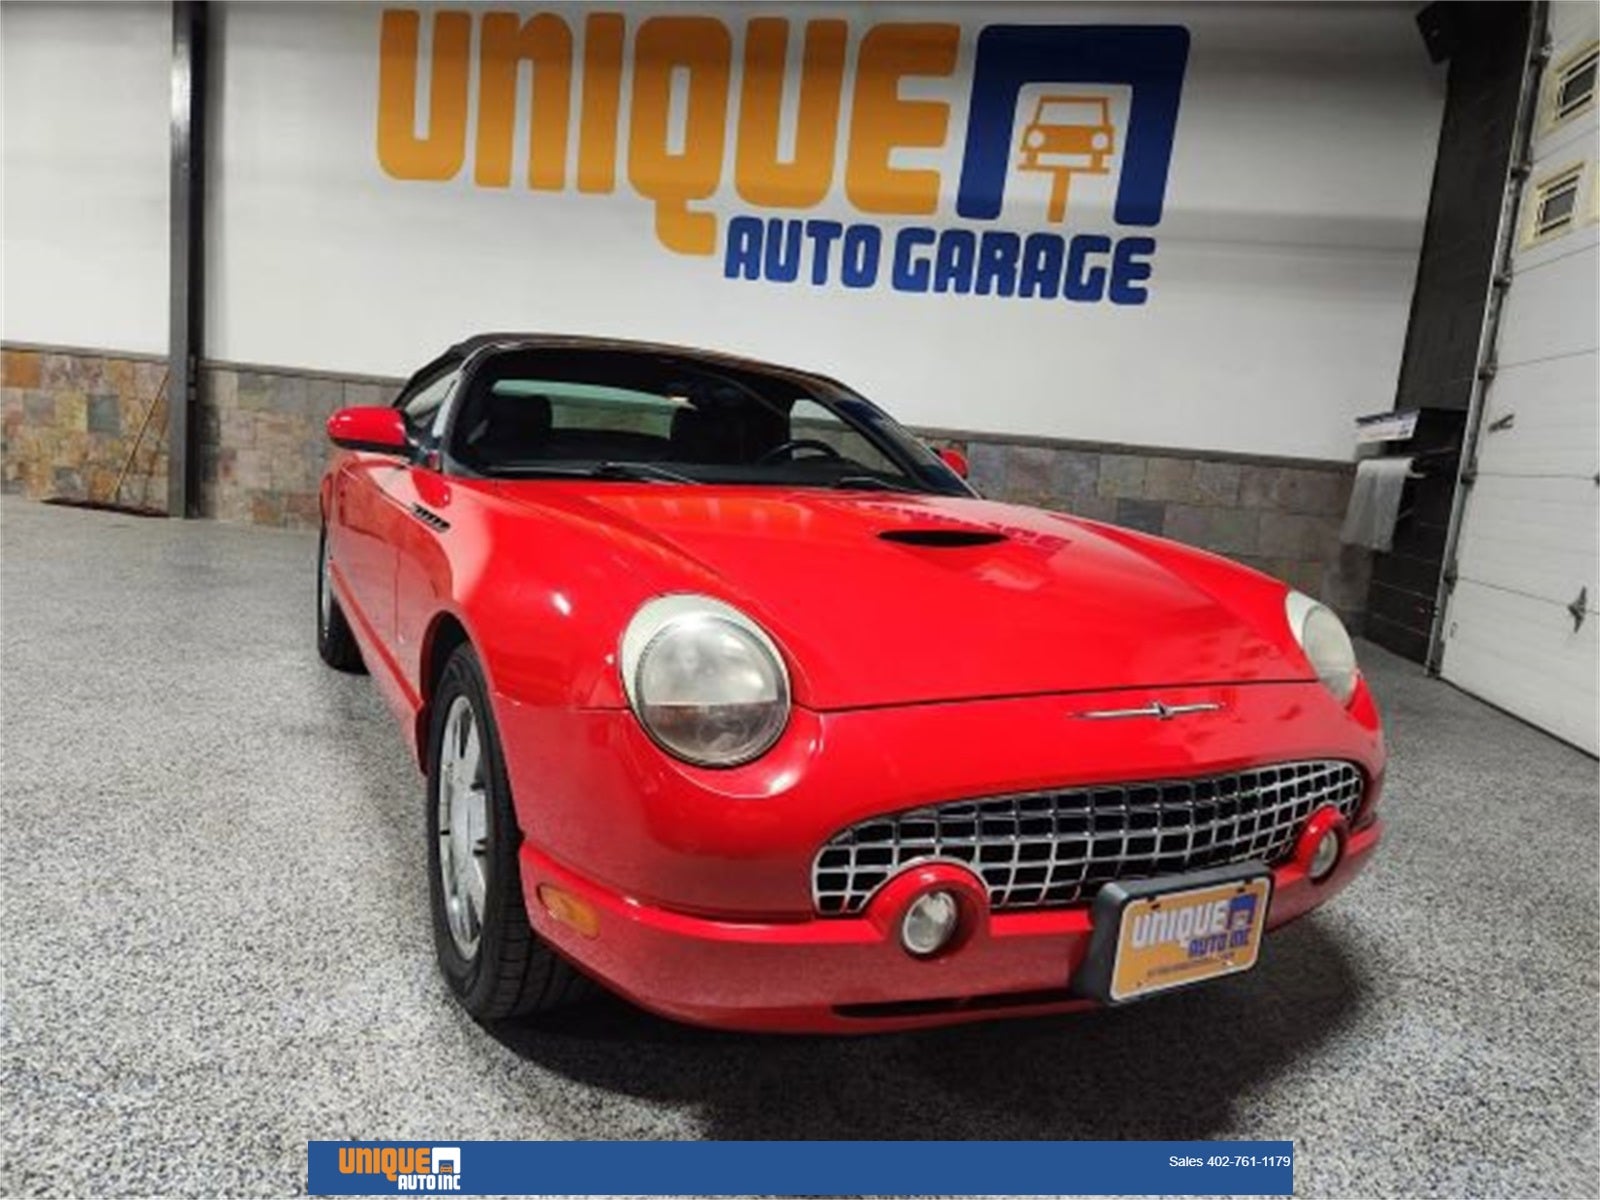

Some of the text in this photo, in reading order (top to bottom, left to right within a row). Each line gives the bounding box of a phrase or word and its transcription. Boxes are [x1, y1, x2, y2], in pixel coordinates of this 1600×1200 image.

[376, 9, 962, 256] UNIQUE
[724, 215, 1157, 306] AUTO GARAGE
[1132, 901, 1230, 948] UNIQUE
[1188, 933, 1228, 958] AUTO
